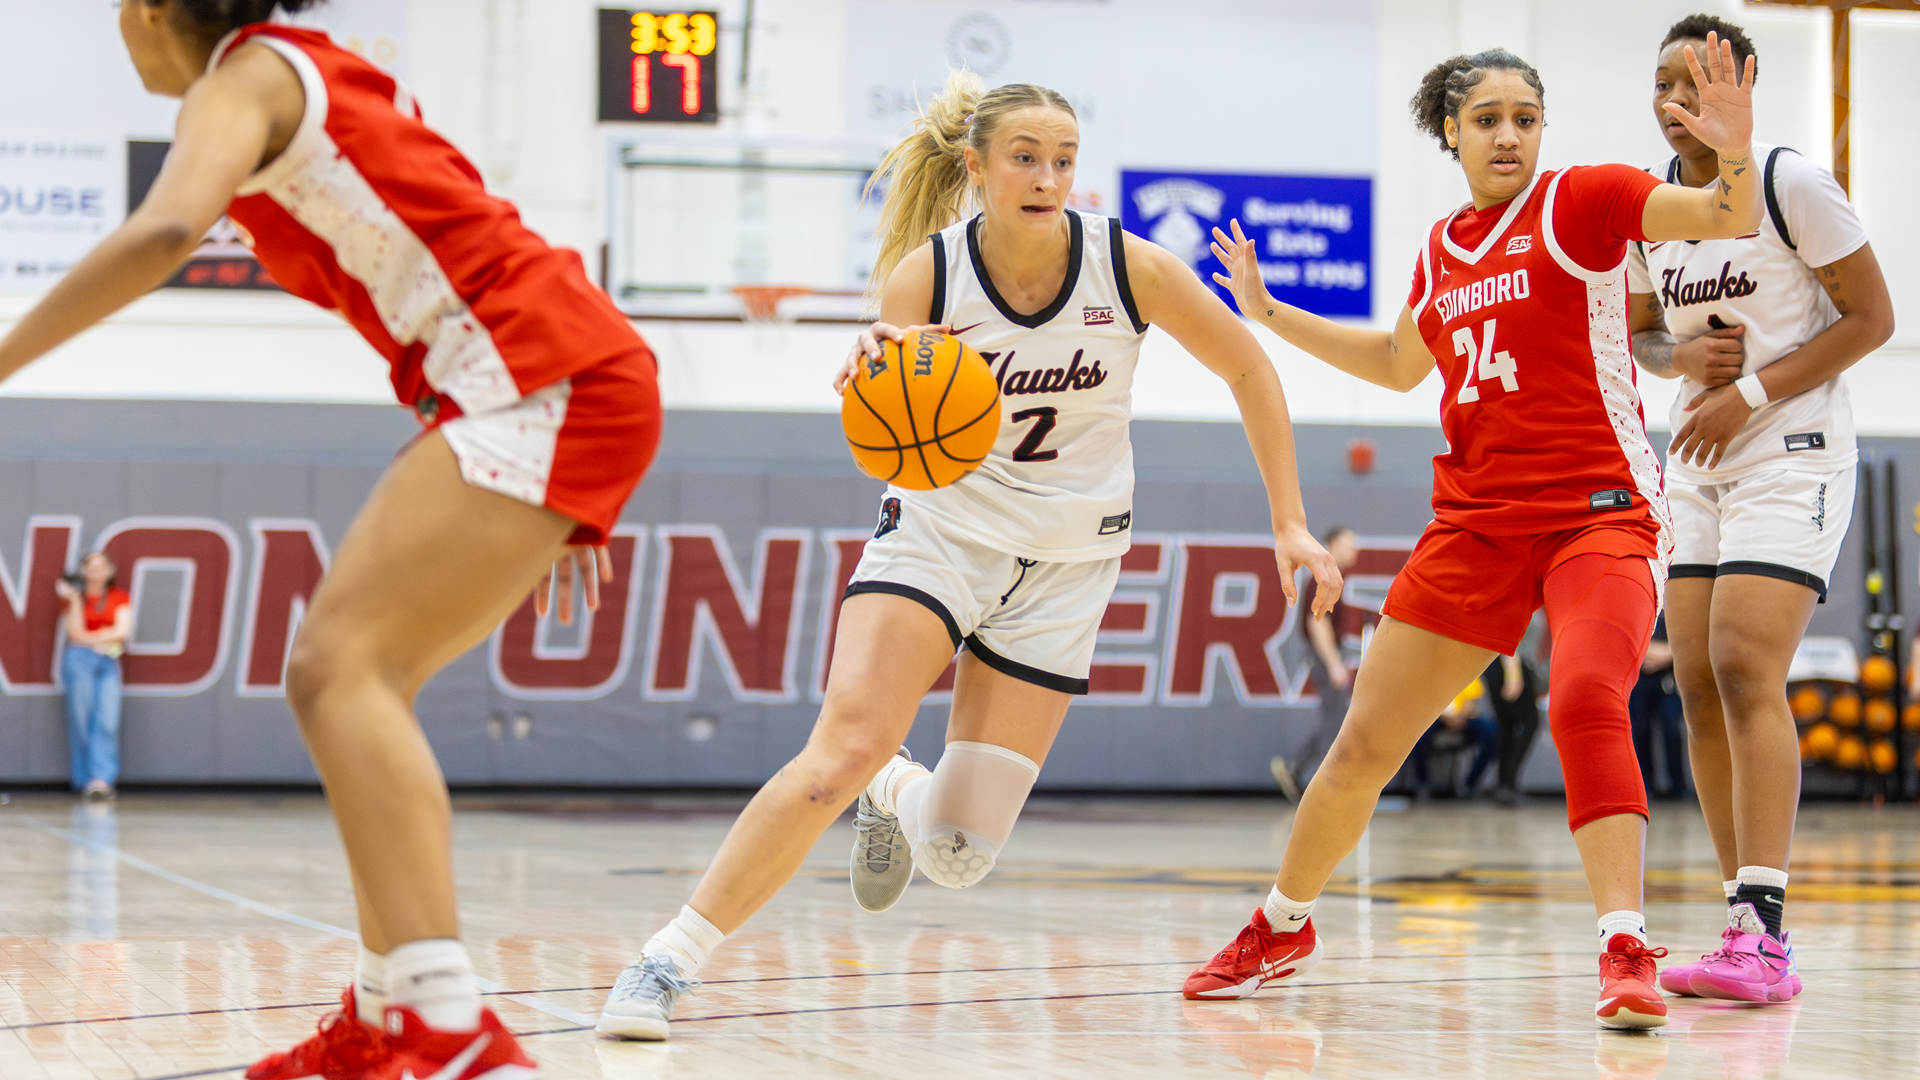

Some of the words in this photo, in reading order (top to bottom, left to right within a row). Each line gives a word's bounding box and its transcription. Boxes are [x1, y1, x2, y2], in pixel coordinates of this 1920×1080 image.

[630, 12, 716, 55] 3:53
[632, 53, 700, 115] 17
[1507, 238, 1532, 251] PSAC
[1435, 269, 1530, 325] EDINBORO
[1662, 261, 1757, 309] Hawks
[1083, 310, 1114, 321] PSAC
[1452, 318, 1519, 404] 24
[1011, 406, 1058, 462] 2
